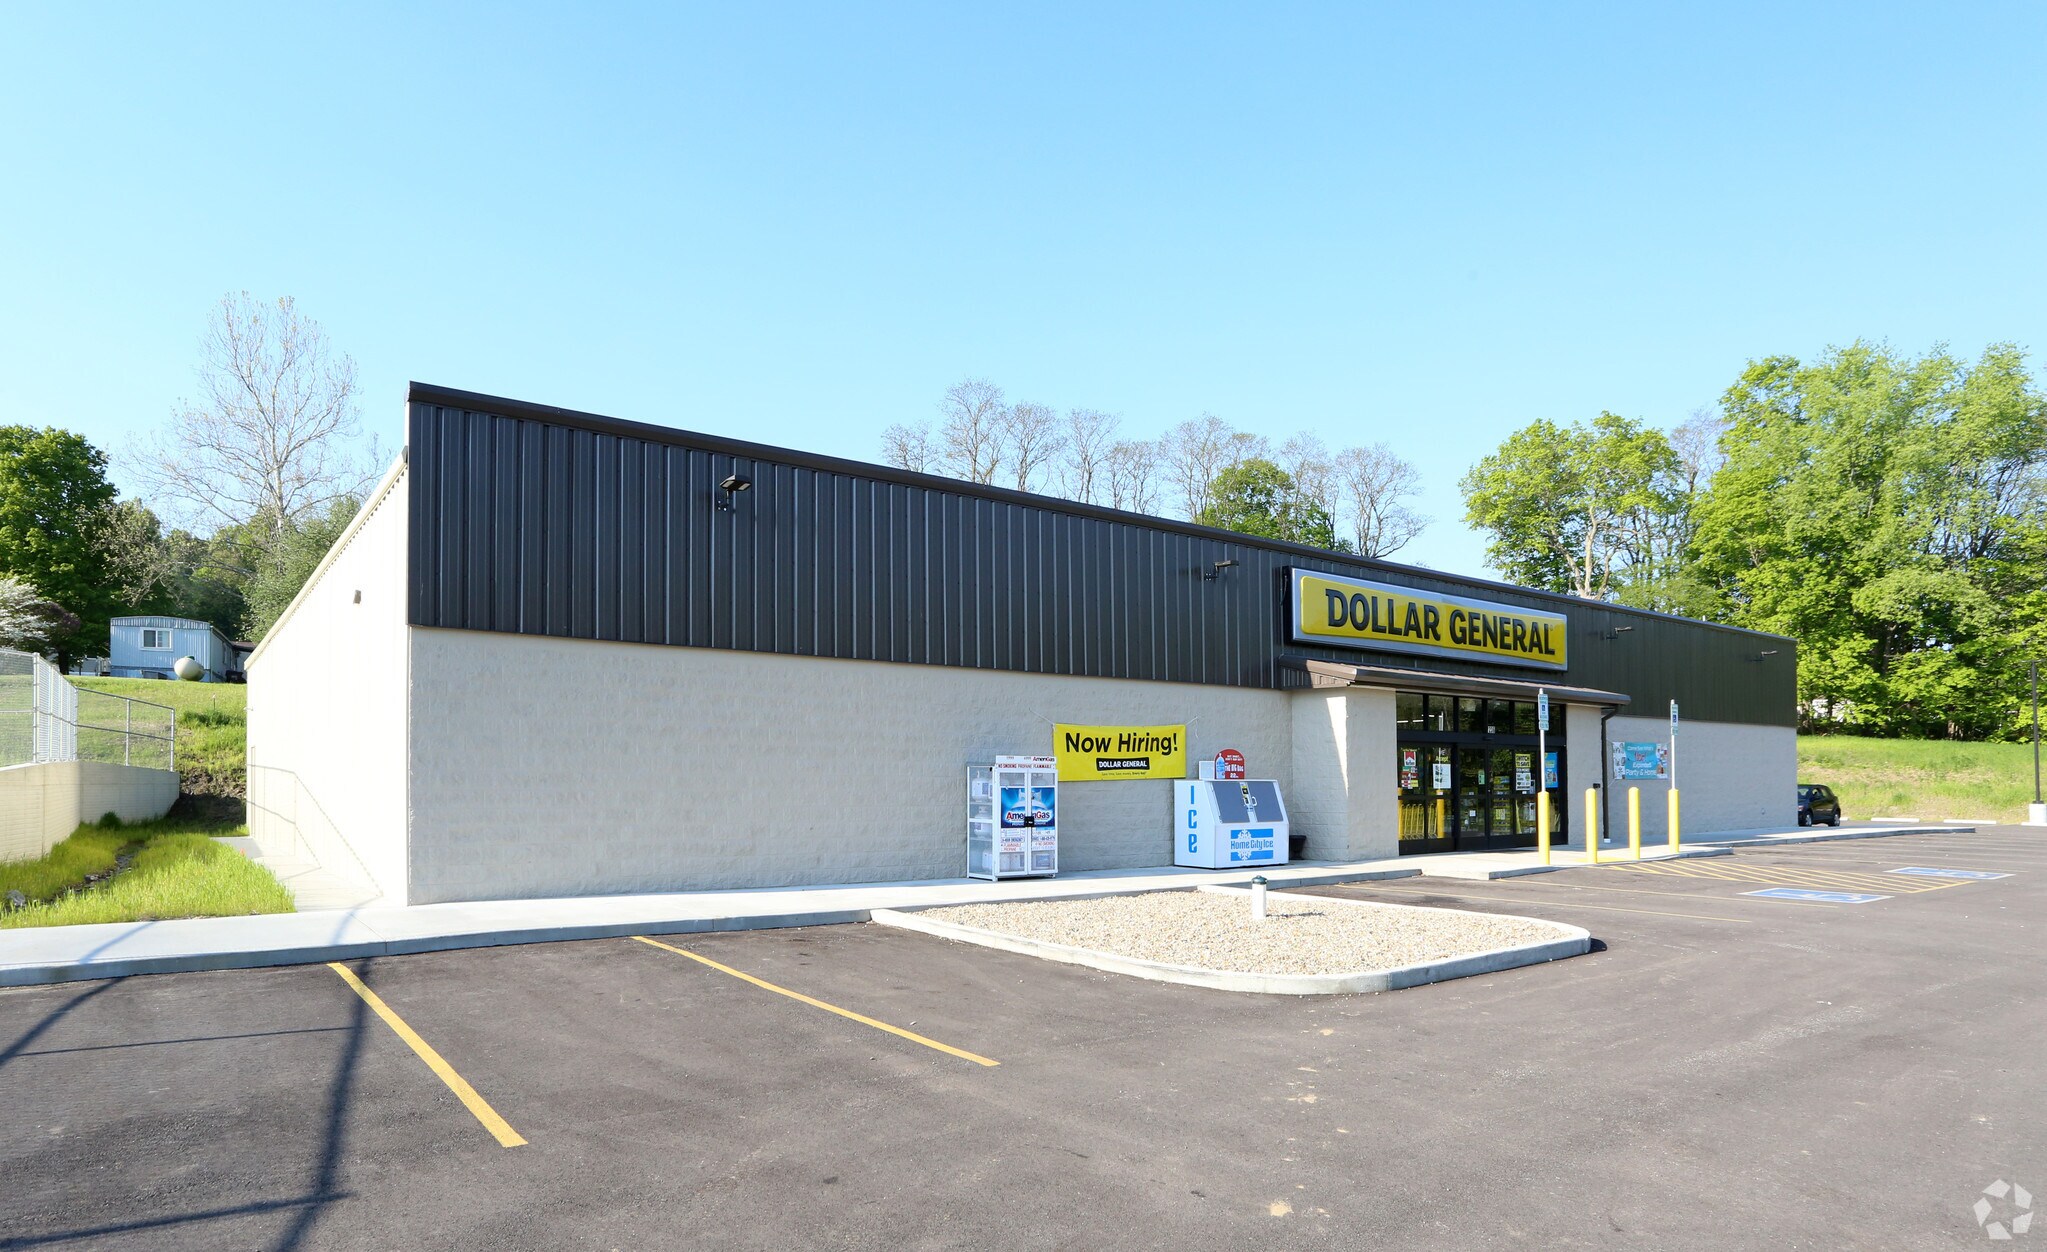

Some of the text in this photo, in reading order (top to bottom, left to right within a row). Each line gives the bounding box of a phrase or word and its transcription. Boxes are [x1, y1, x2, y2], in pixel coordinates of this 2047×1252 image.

[1325, 588, 1555, 655] DOLLAR GENERAL
[1065, 732, 1178, 756] Now Hiring!
[1098, 759, 1148, 768] DOLLAR GENERAL
[1230, 839, 1274, 850] Home City Ice
